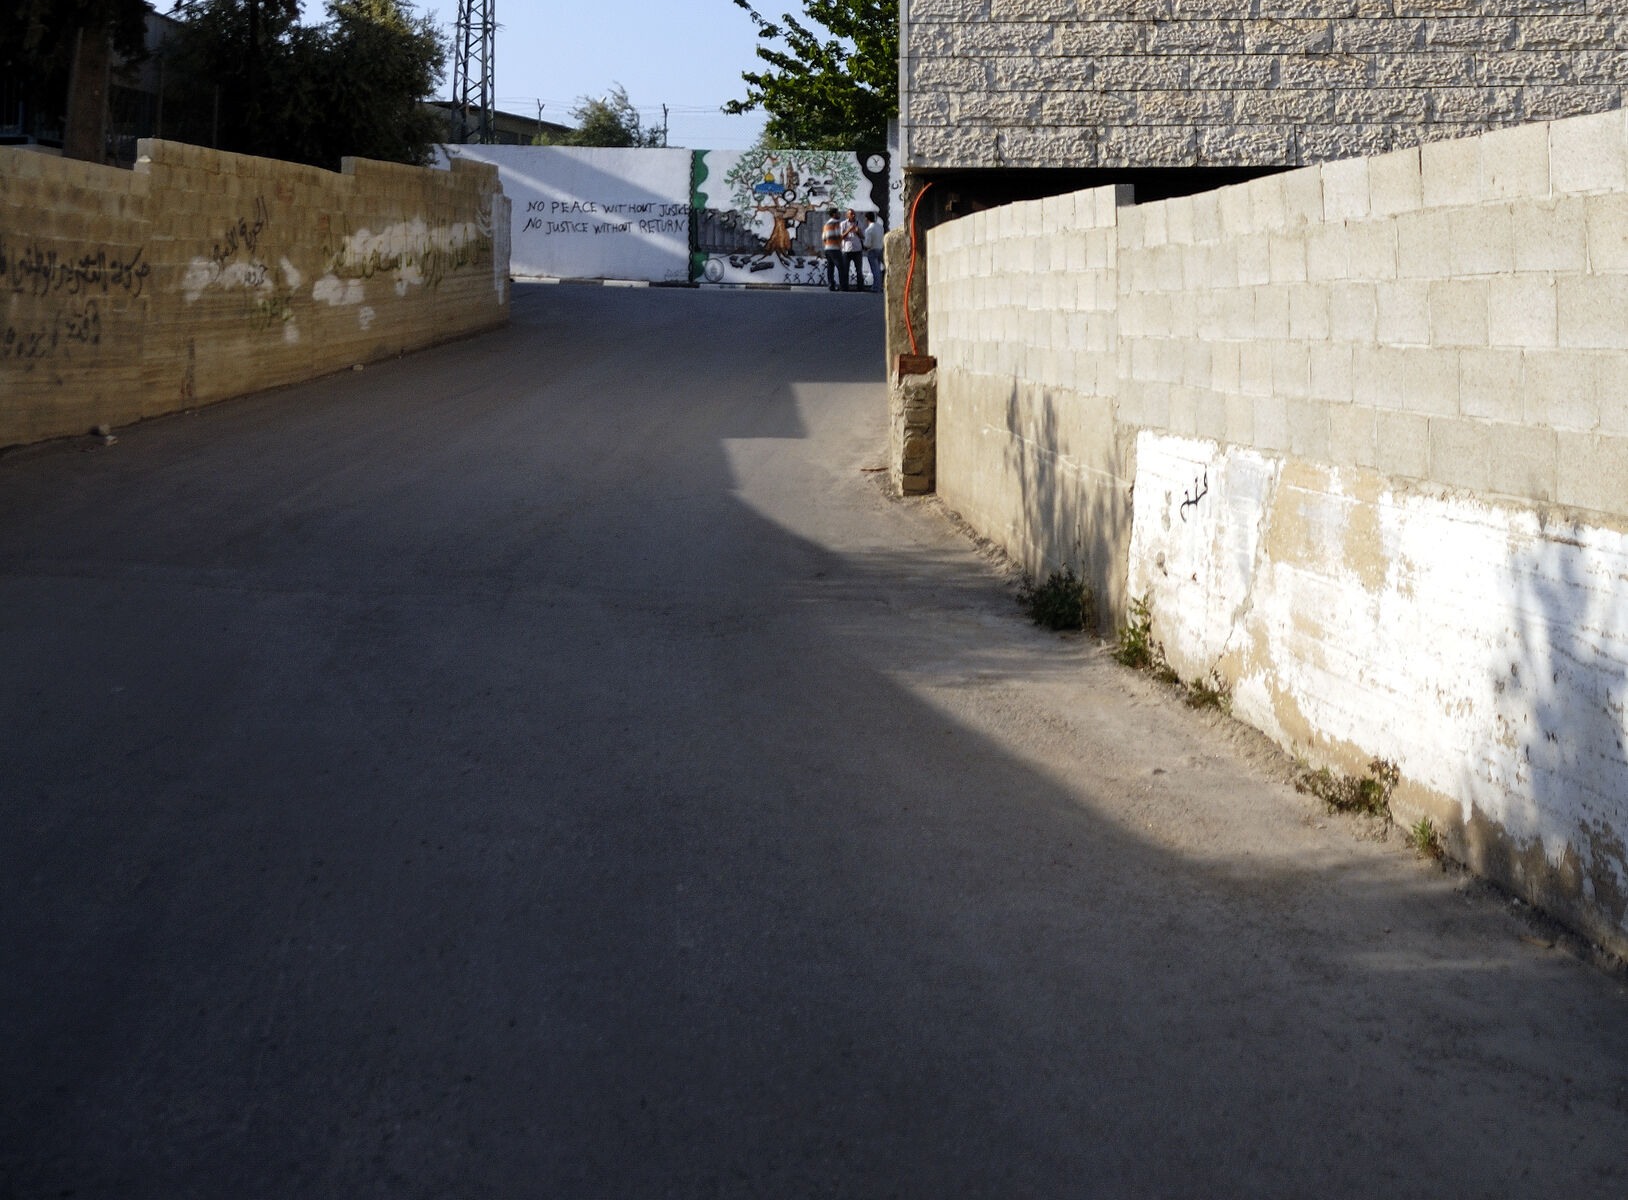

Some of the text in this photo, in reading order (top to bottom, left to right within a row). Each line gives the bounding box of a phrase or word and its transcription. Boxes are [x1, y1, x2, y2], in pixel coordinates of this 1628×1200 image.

[526, 201, 690, 218] NO PEACE WITHOUT JUSTICE
[522, 217, 687, 235] NO JUSTICE WITHOUT RETURN
